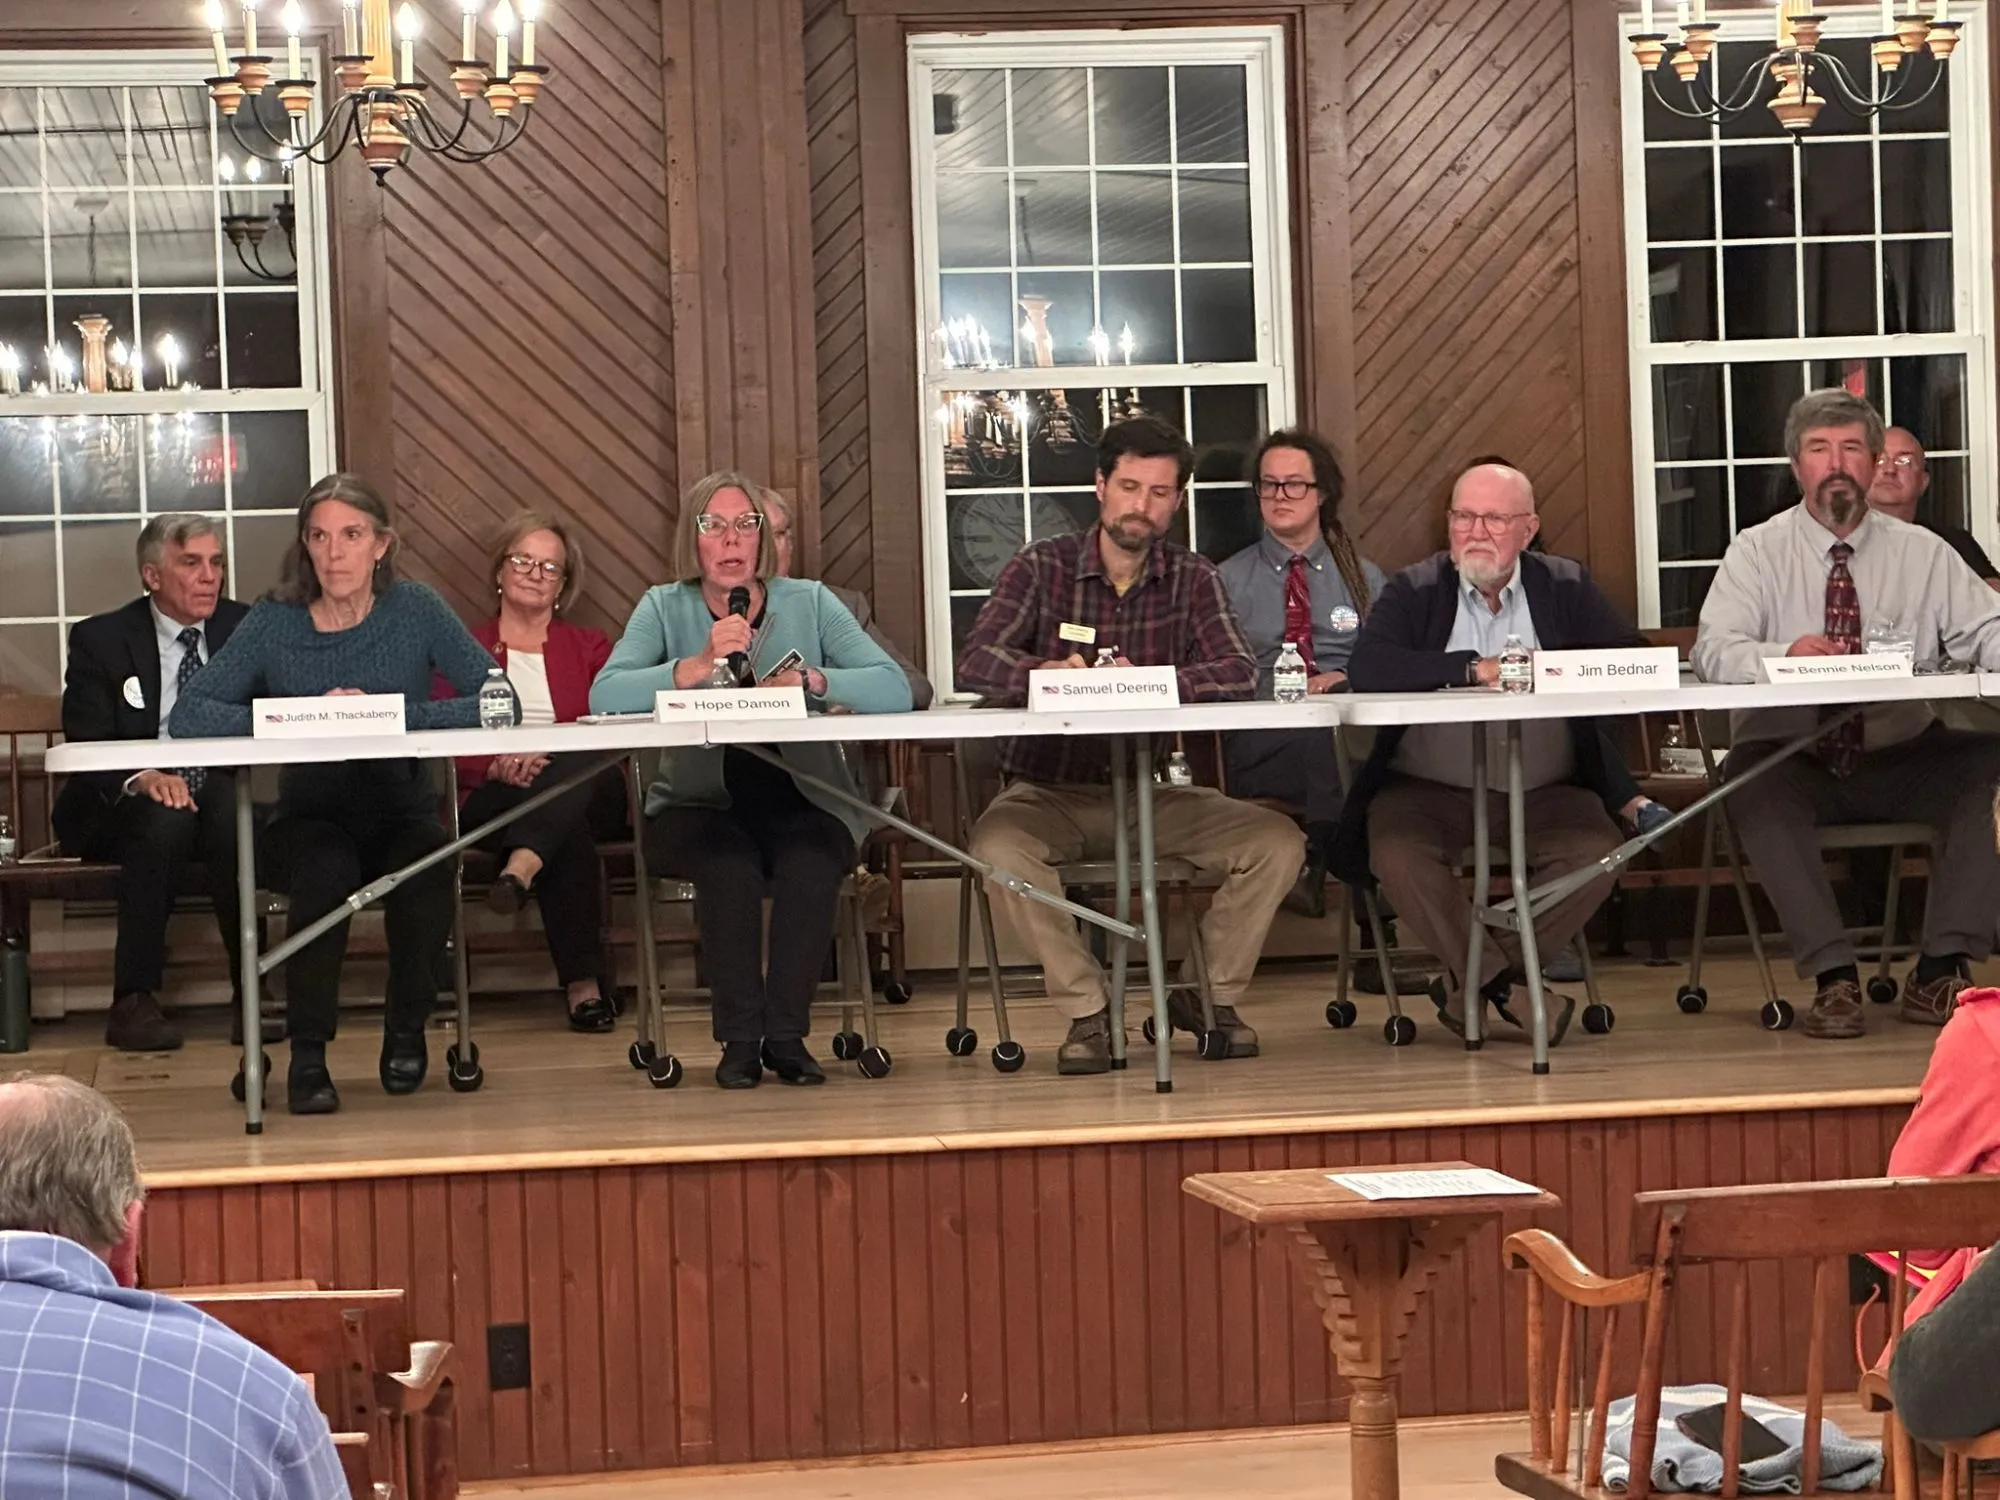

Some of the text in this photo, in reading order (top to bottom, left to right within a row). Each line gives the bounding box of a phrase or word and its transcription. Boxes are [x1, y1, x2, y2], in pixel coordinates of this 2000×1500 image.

[1578, 664, 1658, 676] Jim Bednar
[1798, 663, 1901, 674] Bennie Nelson
[1062, 681, 1168, 695] Samuel Deering
[694, 699, 790, 711] Hope Damon
[285, 710, 398, 722] Judith M. Thackaberry
